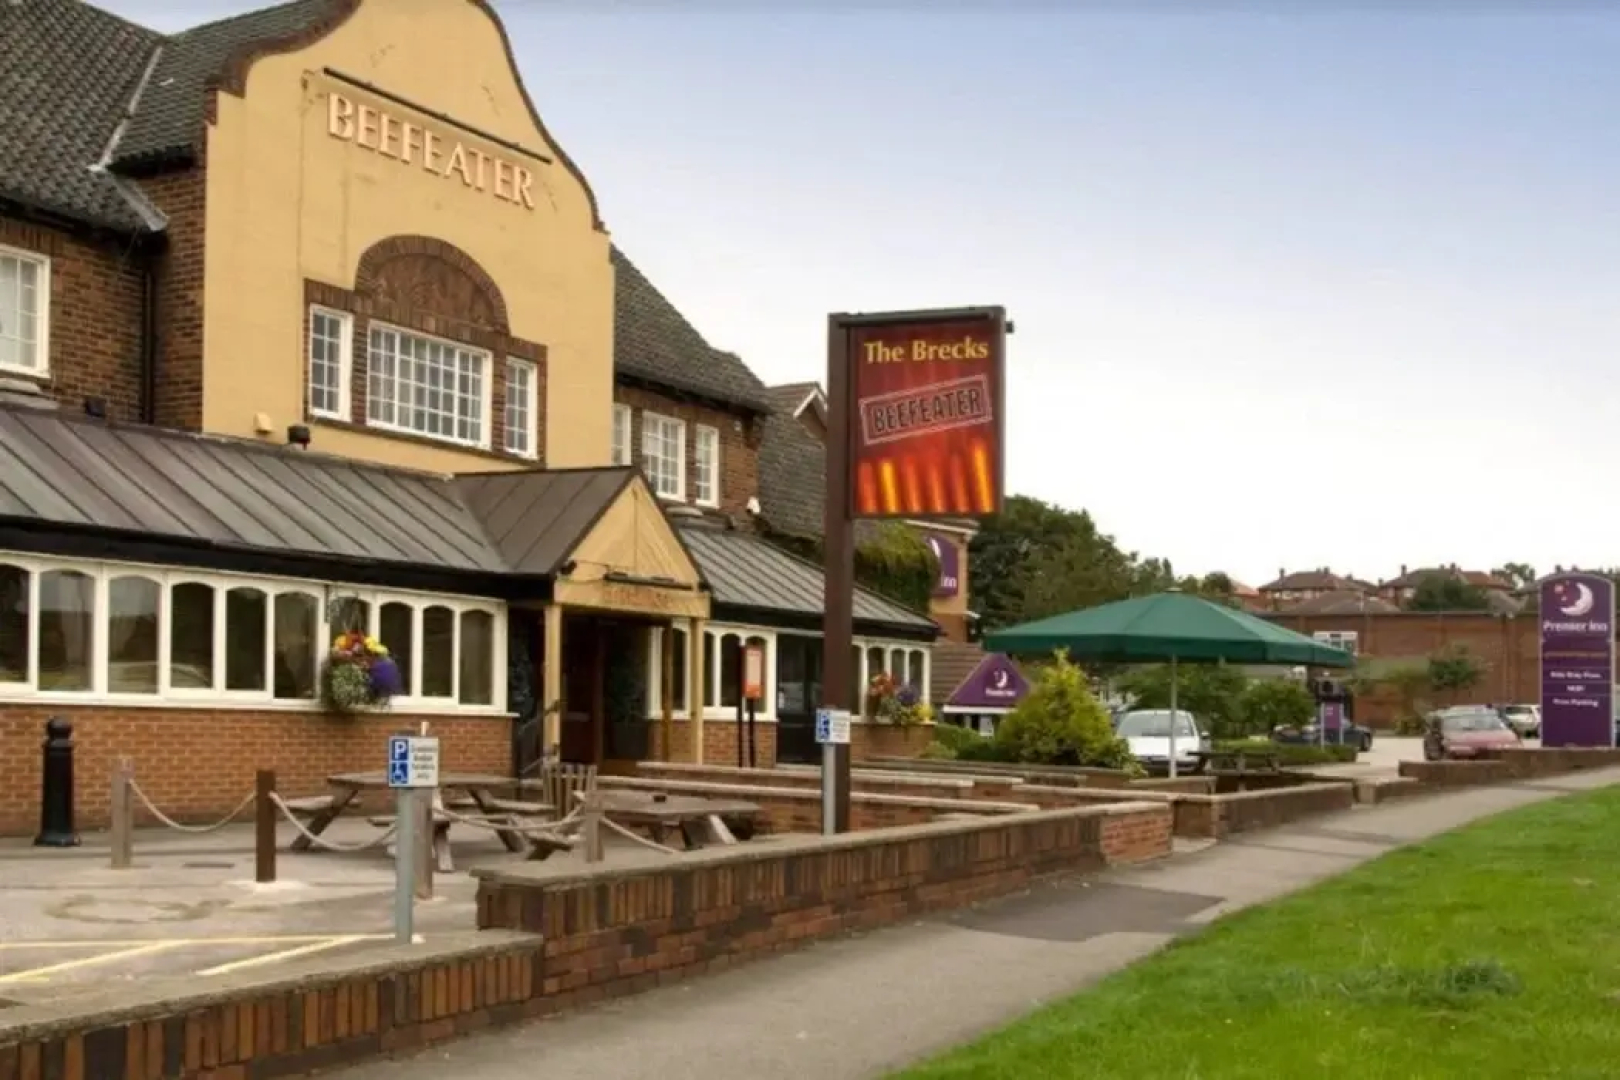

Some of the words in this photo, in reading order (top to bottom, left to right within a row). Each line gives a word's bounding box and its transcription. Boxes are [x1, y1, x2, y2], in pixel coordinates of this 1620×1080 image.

[328, 92, 534, 210] BEEFEATER
[864, 340, 905, 364] The
[912, 335, 989, 362] Brecks
[873, 388, 982, 433] BEEFEATER
[394, 741, 407, 759] P
